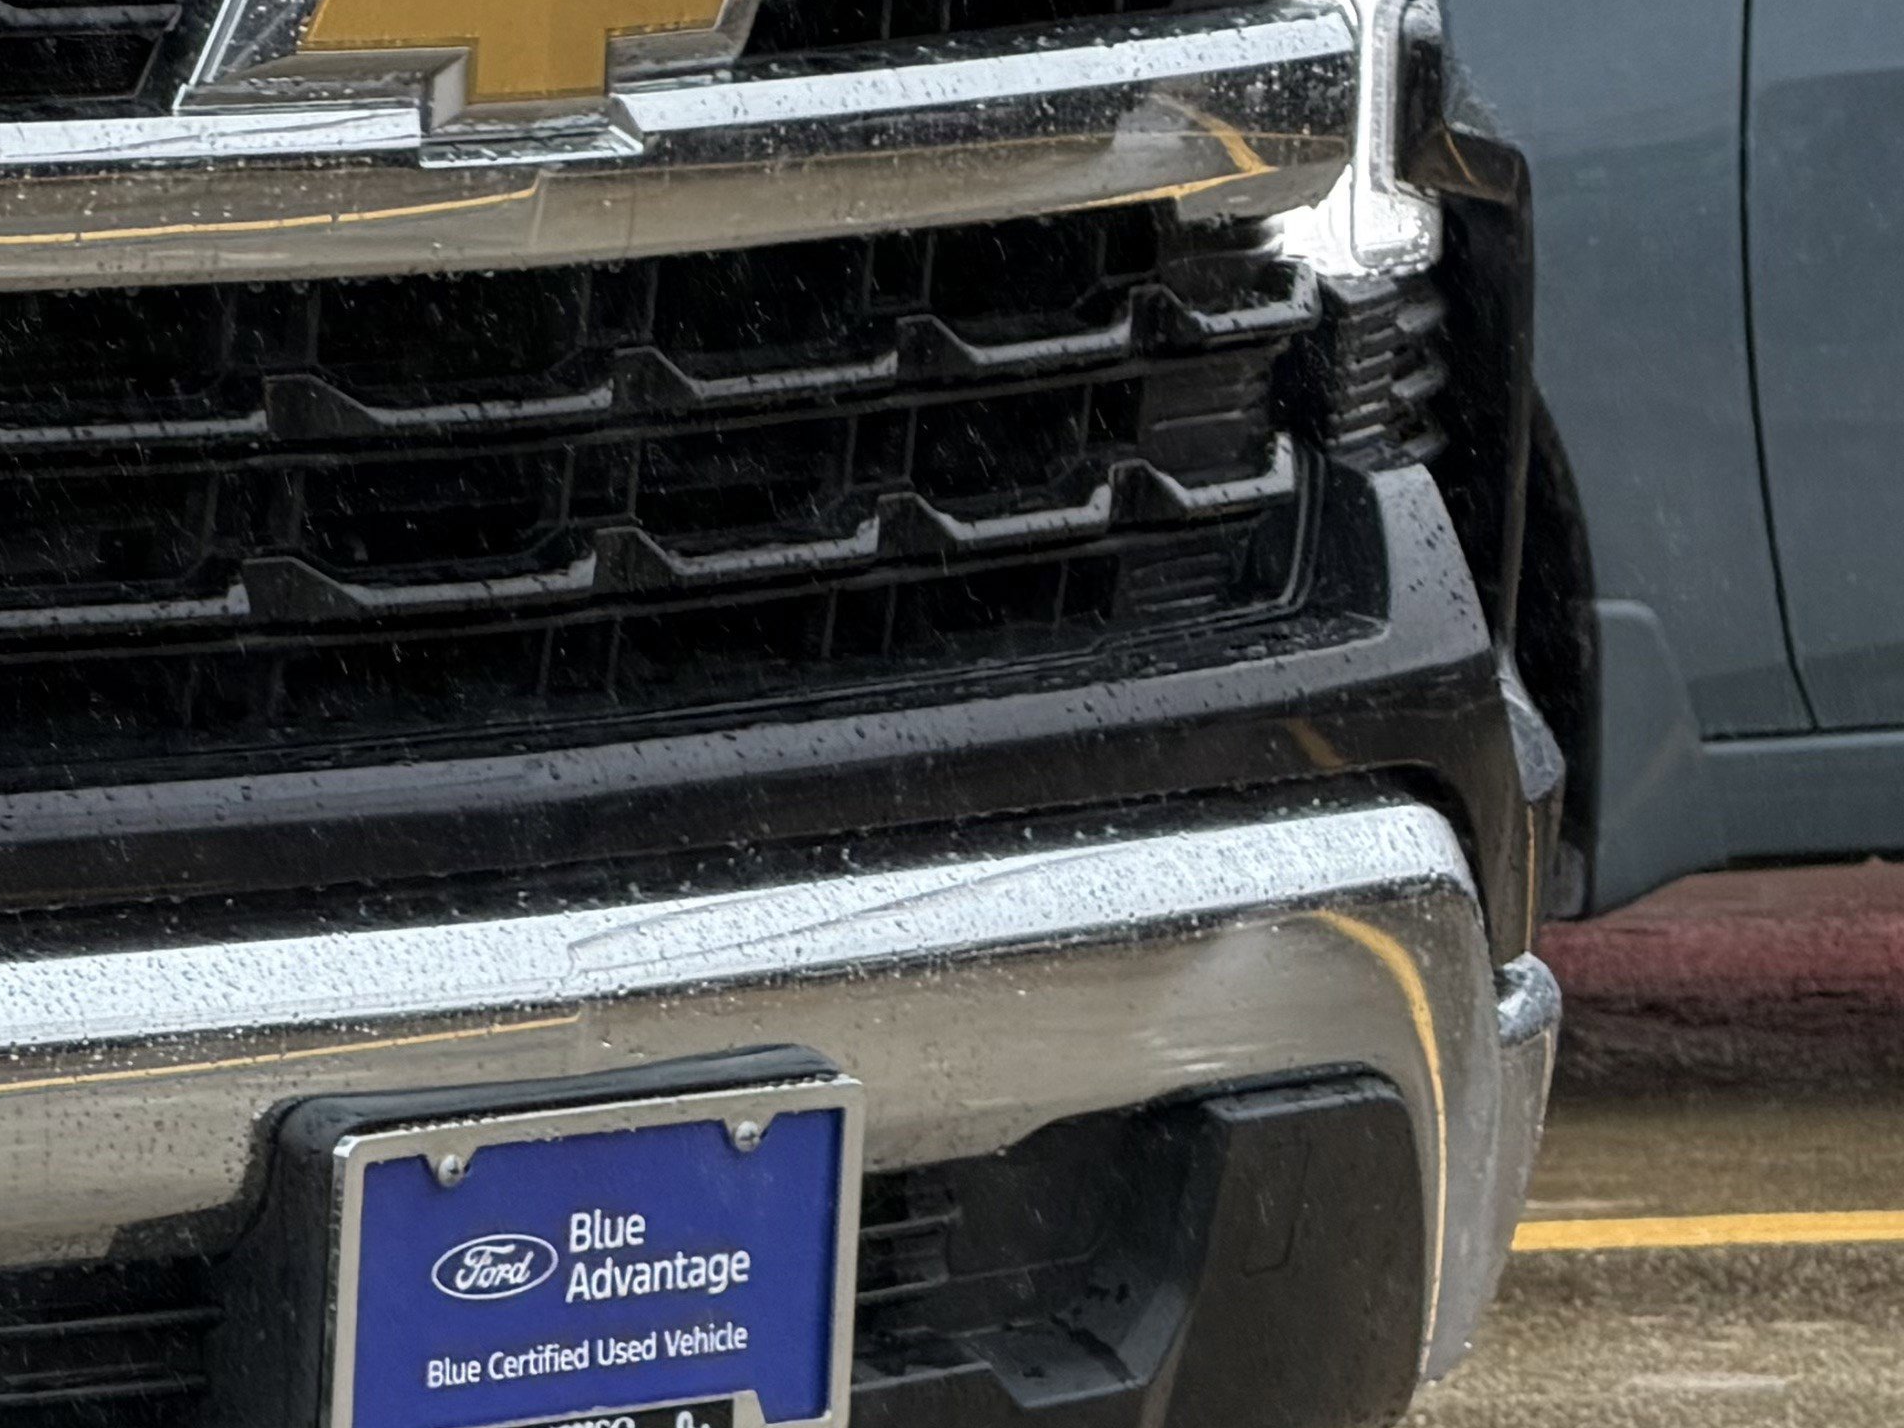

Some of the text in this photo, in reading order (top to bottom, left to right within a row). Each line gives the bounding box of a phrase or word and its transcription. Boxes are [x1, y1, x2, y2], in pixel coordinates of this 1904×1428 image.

[569, 1208, 647, 1254] Blue
[454, 1243, 535, 1291] Ford
[564, 1249, 752, 1304] Advantage
[426, 1321, 749, 1389] Blue Certified Used Vehicle
